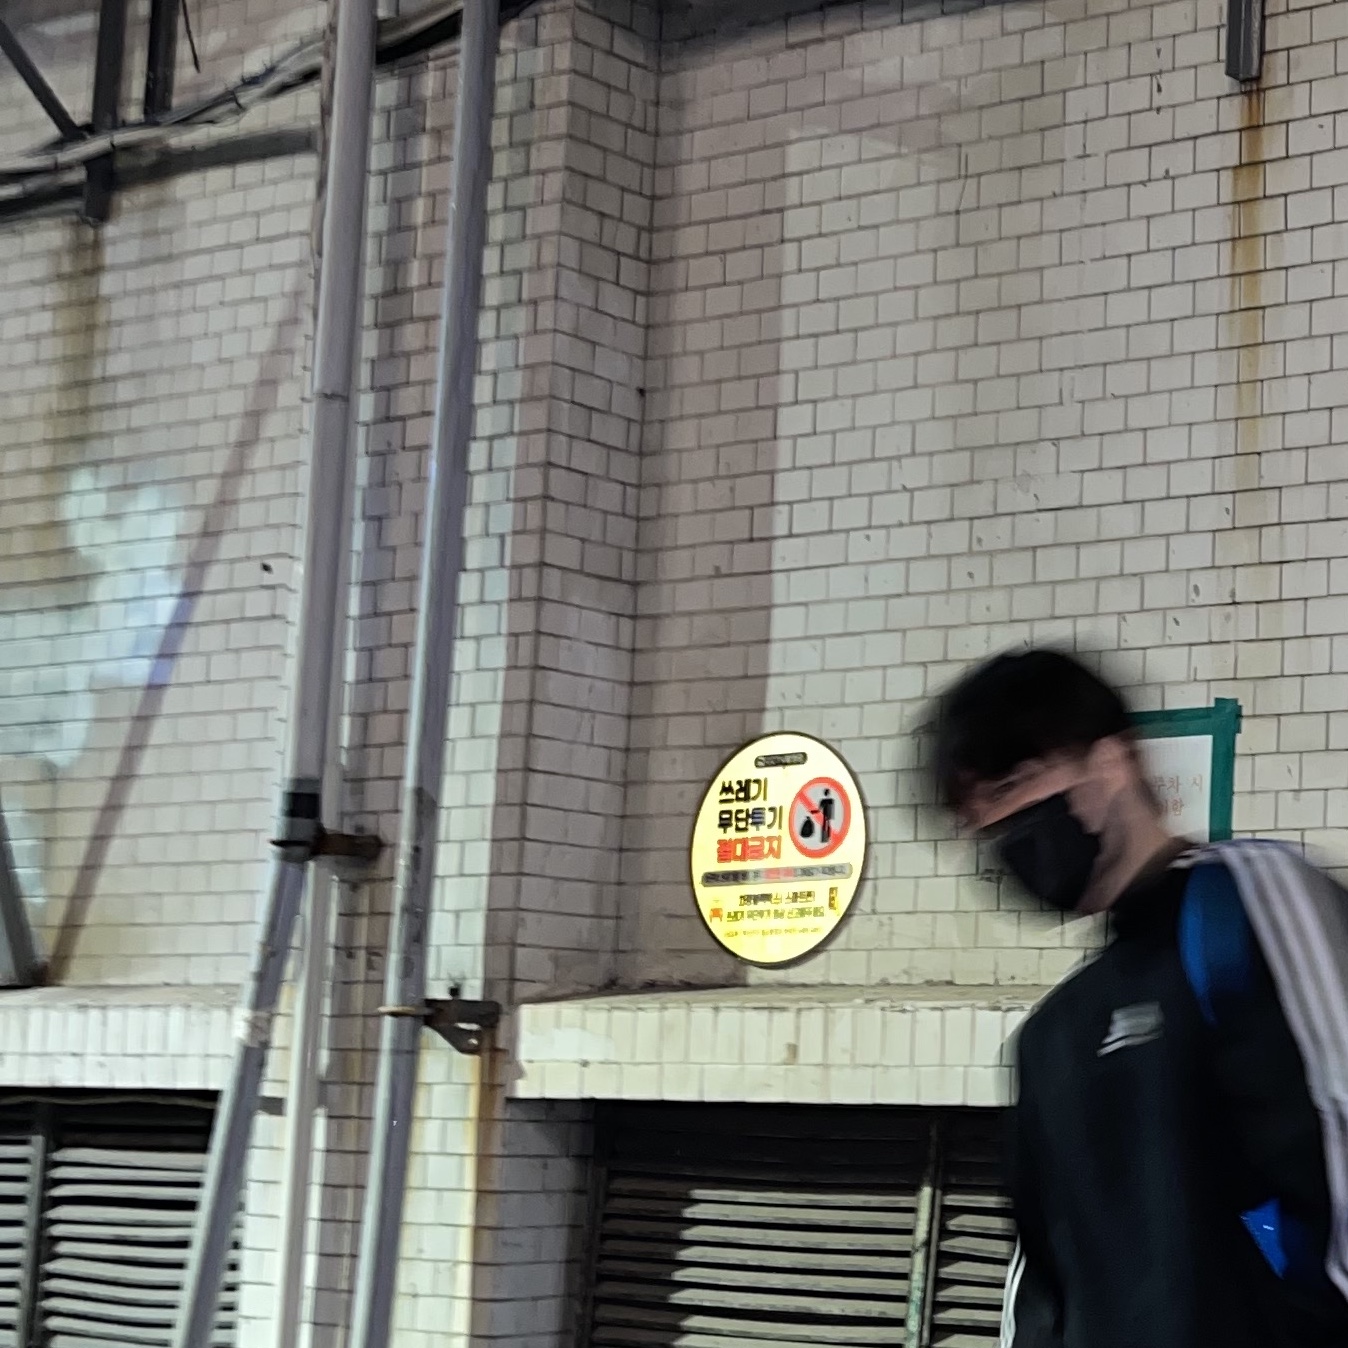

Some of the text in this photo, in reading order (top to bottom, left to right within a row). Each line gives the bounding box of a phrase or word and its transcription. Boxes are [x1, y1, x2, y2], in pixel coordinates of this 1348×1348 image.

[718, 777, 768, 804] 쓰레기
[717, 805, 783, 834] 무단투기
[716, 834, 782, 863] 절대금지
